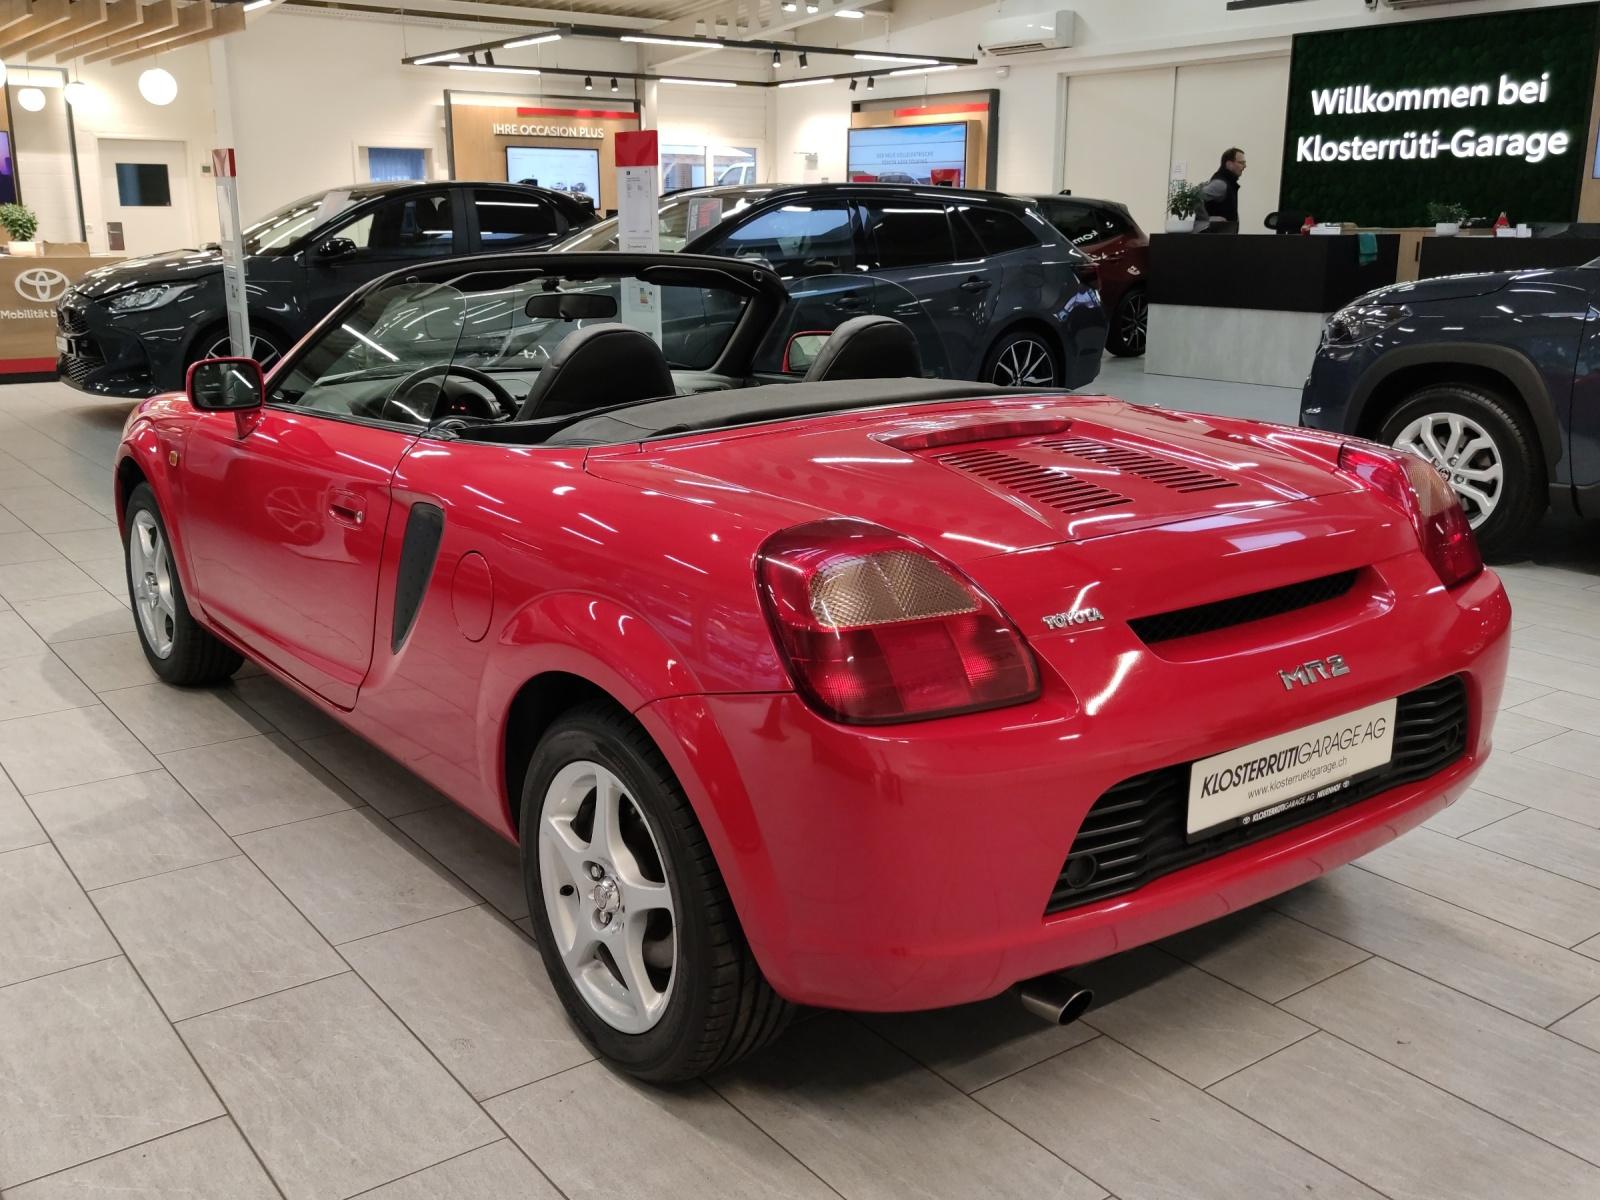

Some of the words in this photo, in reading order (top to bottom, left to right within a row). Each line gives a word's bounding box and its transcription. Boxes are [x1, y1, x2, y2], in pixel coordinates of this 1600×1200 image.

[1310, 83, 1489, 116] Willkommen
[1497, 71, 1550, 106] bei
[493, 123, 517, 135] IHRE
[520, 124, 577, 138] OCCASION
[579, 127, 604, 138] PLUS
[1295, 127, 1570, 163] Klosterrüti-Garage
[0, 309, 49, 320] Mobilität
[1042, 607, 1105, 630] TOYOTA
[1277, 654, 1351, 690] MR2
[1200, 724, 1362, 799] KLOSTERRÜTIGARAGE
[1361, 717, 1387, 744] AG
[1247, 756, 1348, 800] www.klosterruetigarage.ch
